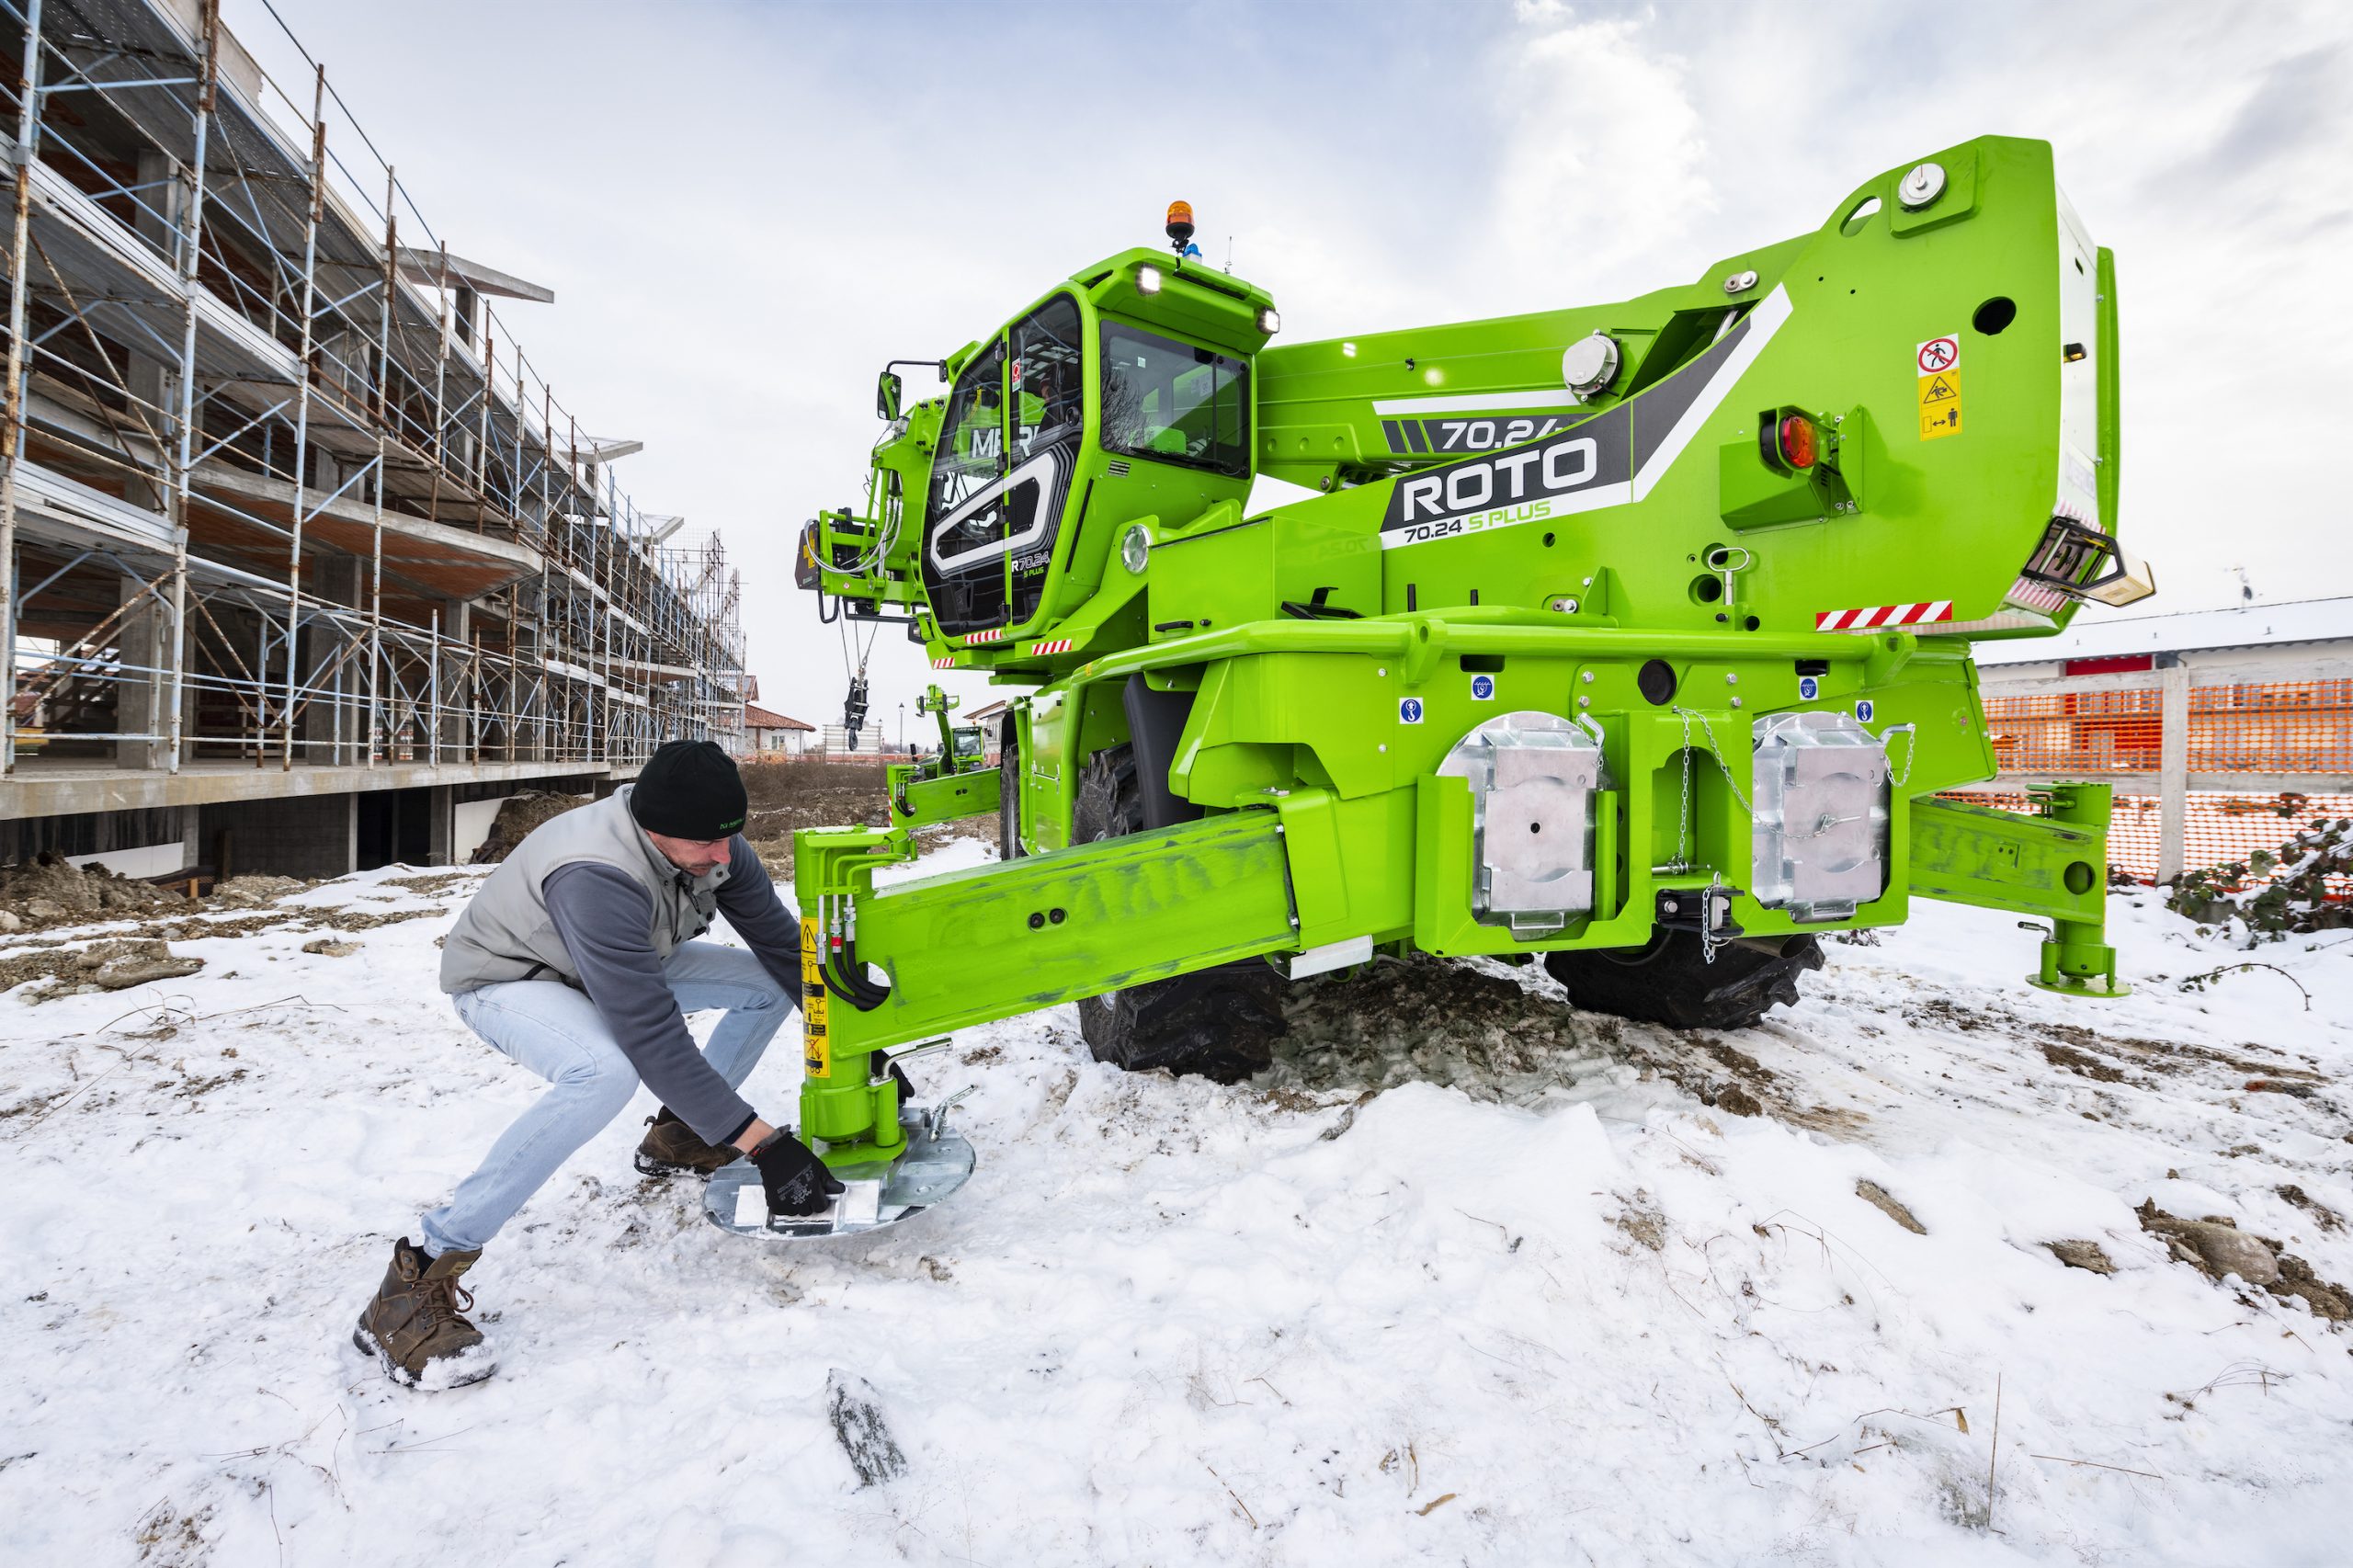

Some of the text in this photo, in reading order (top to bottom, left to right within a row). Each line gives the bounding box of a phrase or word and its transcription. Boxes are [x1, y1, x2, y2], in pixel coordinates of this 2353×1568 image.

[1404, 437, 1597, 522] ROTO
[1404, 501, 1552, 543] 70.24 S PLUS
